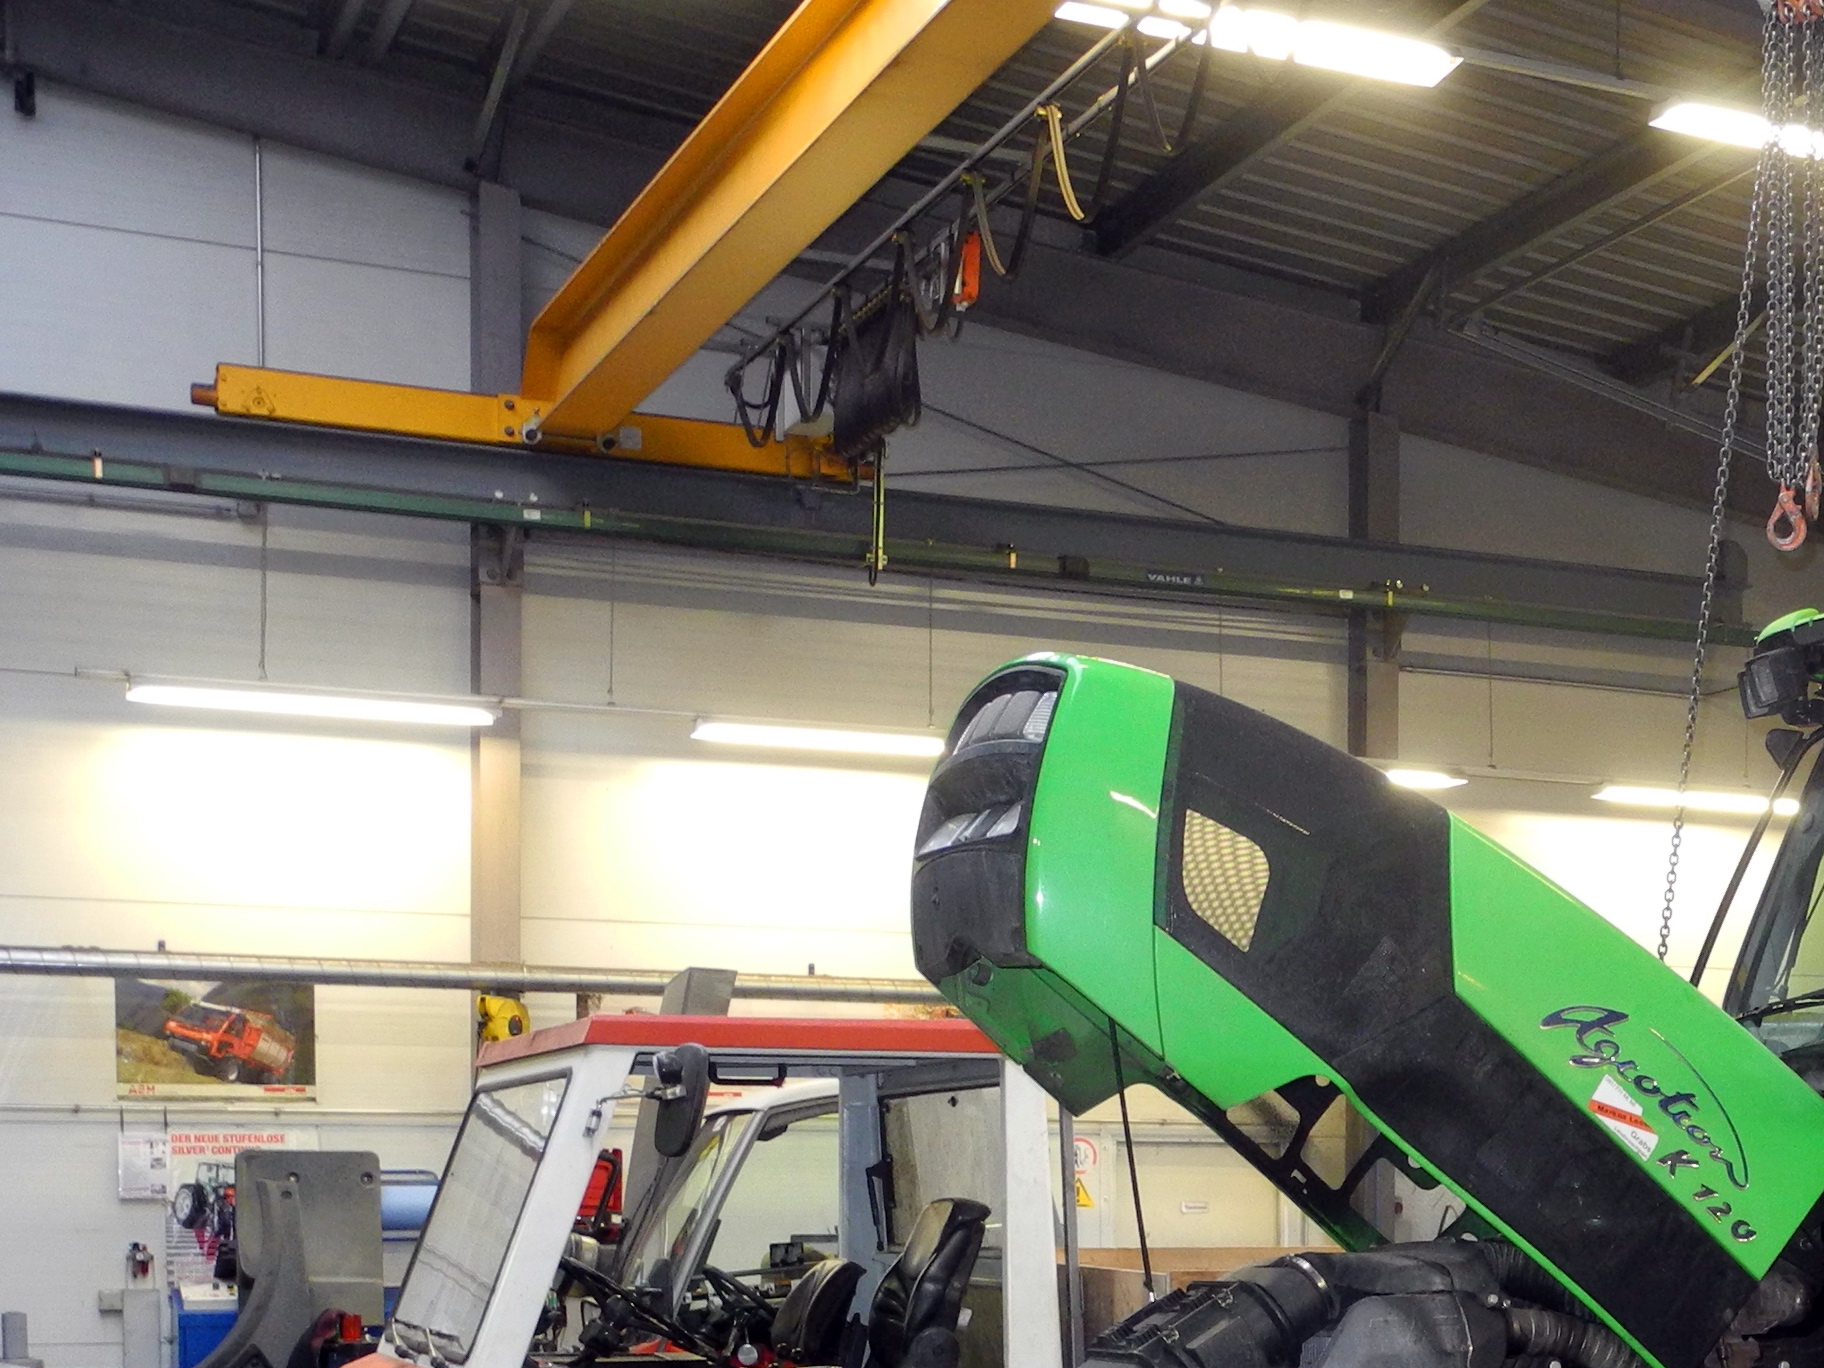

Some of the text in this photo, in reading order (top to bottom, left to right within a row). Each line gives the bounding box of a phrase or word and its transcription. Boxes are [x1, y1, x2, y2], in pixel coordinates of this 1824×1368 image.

[1147, 573, 1192, 585] VAHLE
[1540, 1005, 1750, 1190] Agrotron
[171, 1133, 285, 1144] DER NEUE STUFENLOSE
[1656, 1149, 1758, 1243] K 120
